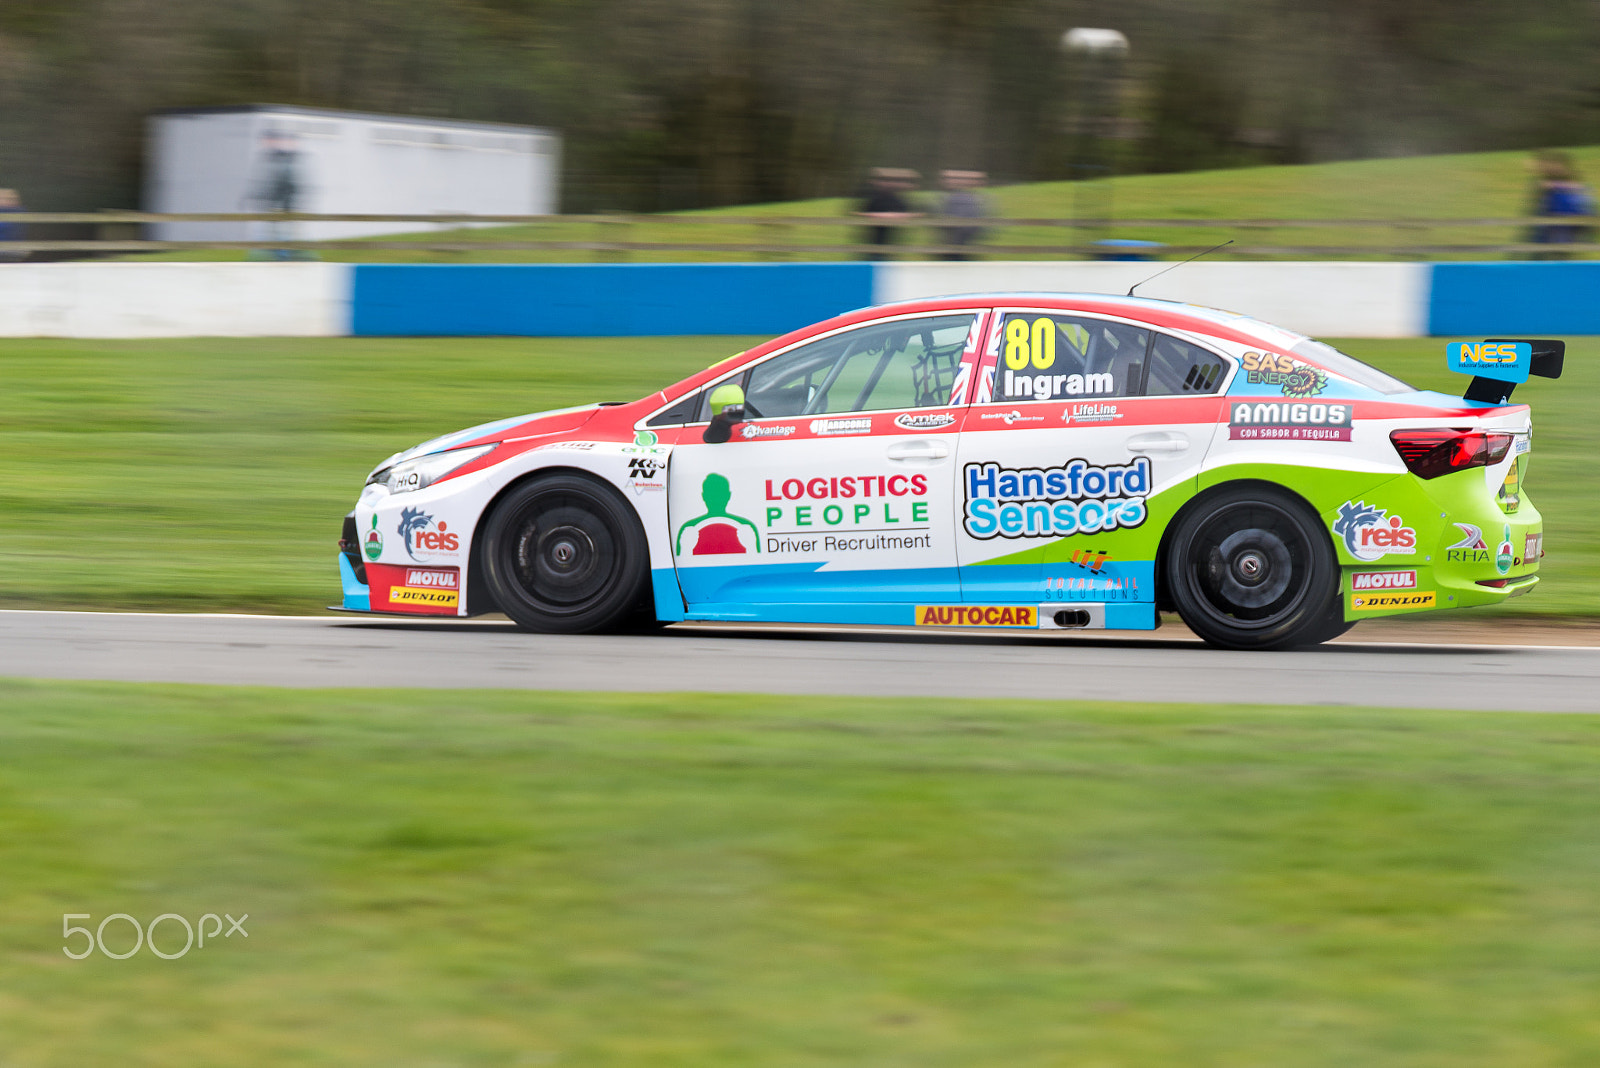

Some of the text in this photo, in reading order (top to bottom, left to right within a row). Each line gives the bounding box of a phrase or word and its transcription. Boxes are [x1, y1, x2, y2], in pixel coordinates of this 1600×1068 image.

[1005, 317, 1056, 370] 80
[1460, 343, 1517, 363] NES
[1241, 352, 1295, 374] SAS
[1004, 370, 1114, 400] Ingram
[1248, 371, 1309, 387] ENERGY
[900, 412, 955, 422] Amtek
[1073, 403, 1117, 416] LifeLine
[1234, 403, 1346, 425] AMIGOS
[745, 424, 796, 438] Advantage
[1240, 428, 1340, 439] CON SABOR A TEQUILA
[765, 474, 929, 501] LOGISTICS
[968, 460, 1149, 499] Hansford
[766, 501, 929, 527] PEOPLE
[968, 497, 1144, 534] Sensors
[415, 520, 459, 551] reis
[1360, 516, 1416, 548] reis
[767, 533, 931, 554] Driver Recruitment
[1447, 550, 1490, 562] RHA
[409, 571, 456, 587] MOTUL
[1046, 576, 1139, 590] TOTAL RAIL
[1354, 572, 1414, 589] MOTUL
[401, 591, 456, 602] DUNLOP
[1045, 588, 1139, 600] SOLUTIONS
[1367, 596, 1433, 606] DUNLOP
[922, 606, 1031, 625] AUTOCAR
